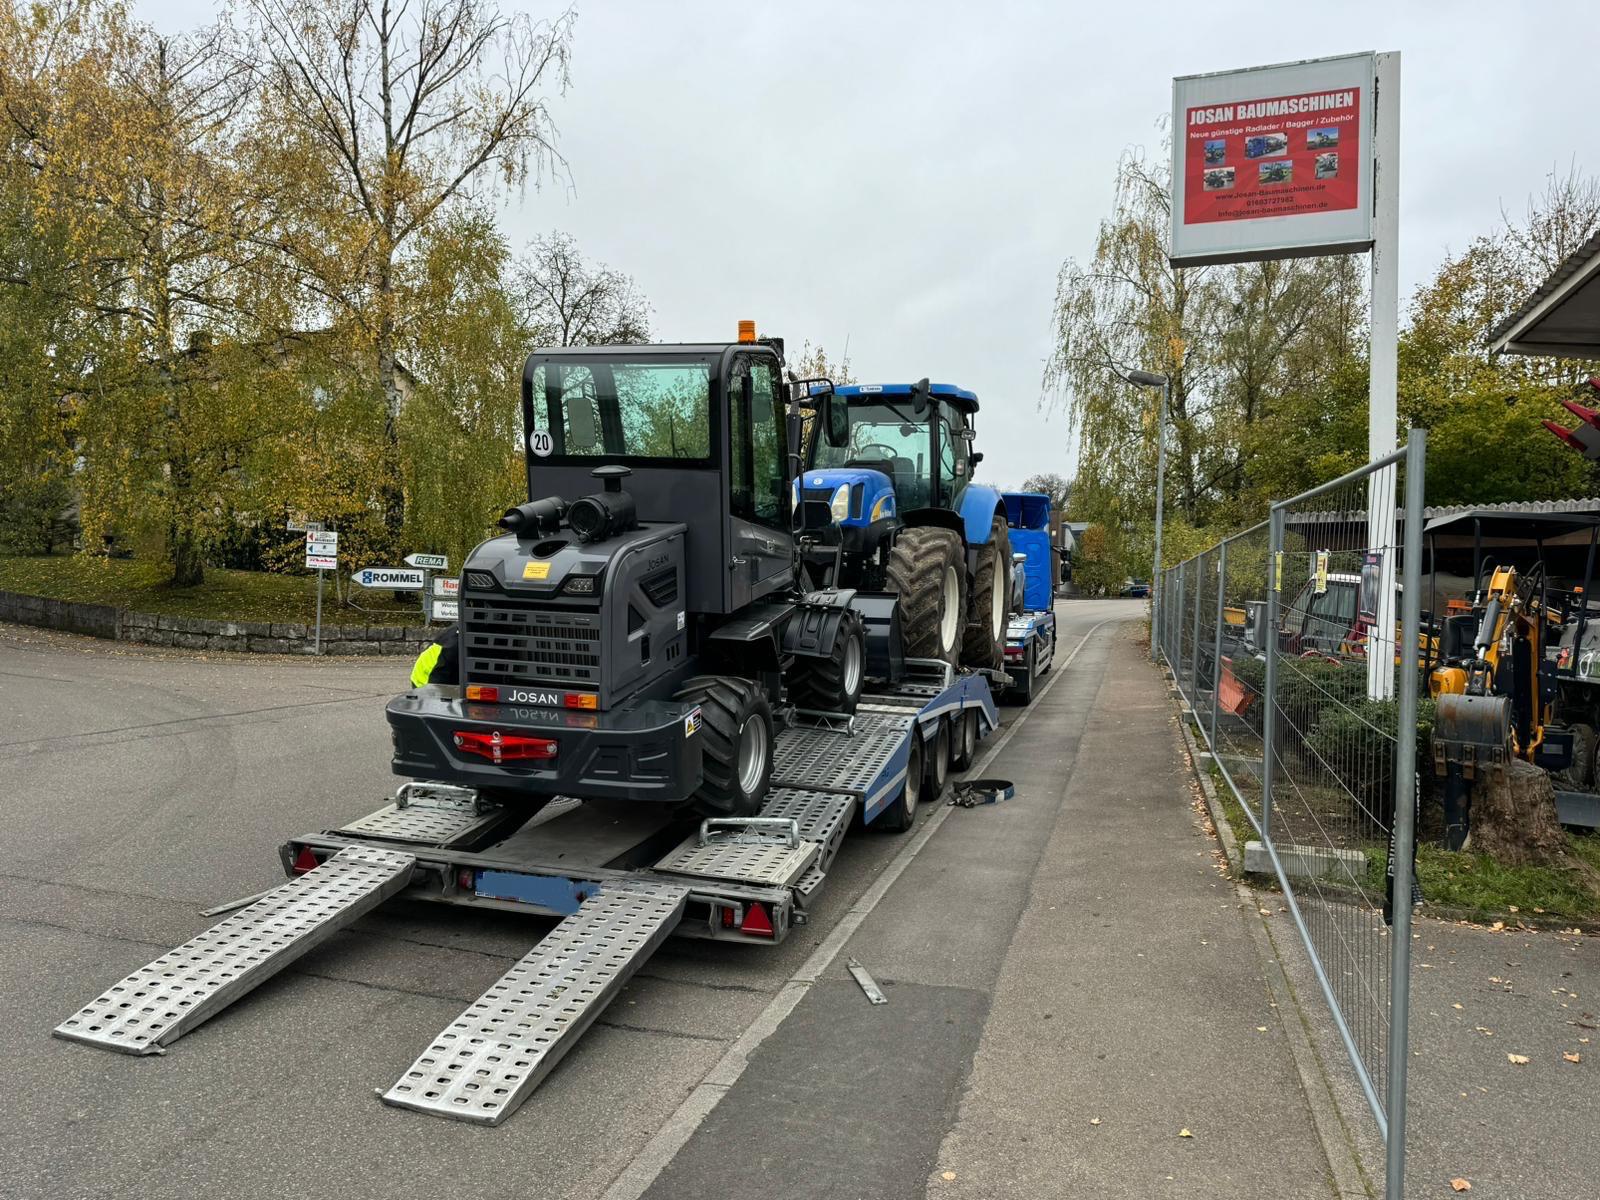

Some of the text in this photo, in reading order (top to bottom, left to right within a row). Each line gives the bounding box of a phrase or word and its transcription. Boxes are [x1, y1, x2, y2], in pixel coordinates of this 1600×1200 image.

[1189, 91, 1354, 126] JOSAN BAUMASCHINEN
[1190, 131, 1210, 139] Neue
[1211, 127, 1244, 138] günstige
[1245, 123, 1280, 133] Radlader
[1286, 119, 1314, 129] Bagger
[1320, 114, 1355, 125] Zubehör
[534, 433, 549, 451] 20
[416, 556, 443, 566] REMA
[373, 573, 423, 583] ROMMEL
[509, 689, 559, 705] JOSAN
